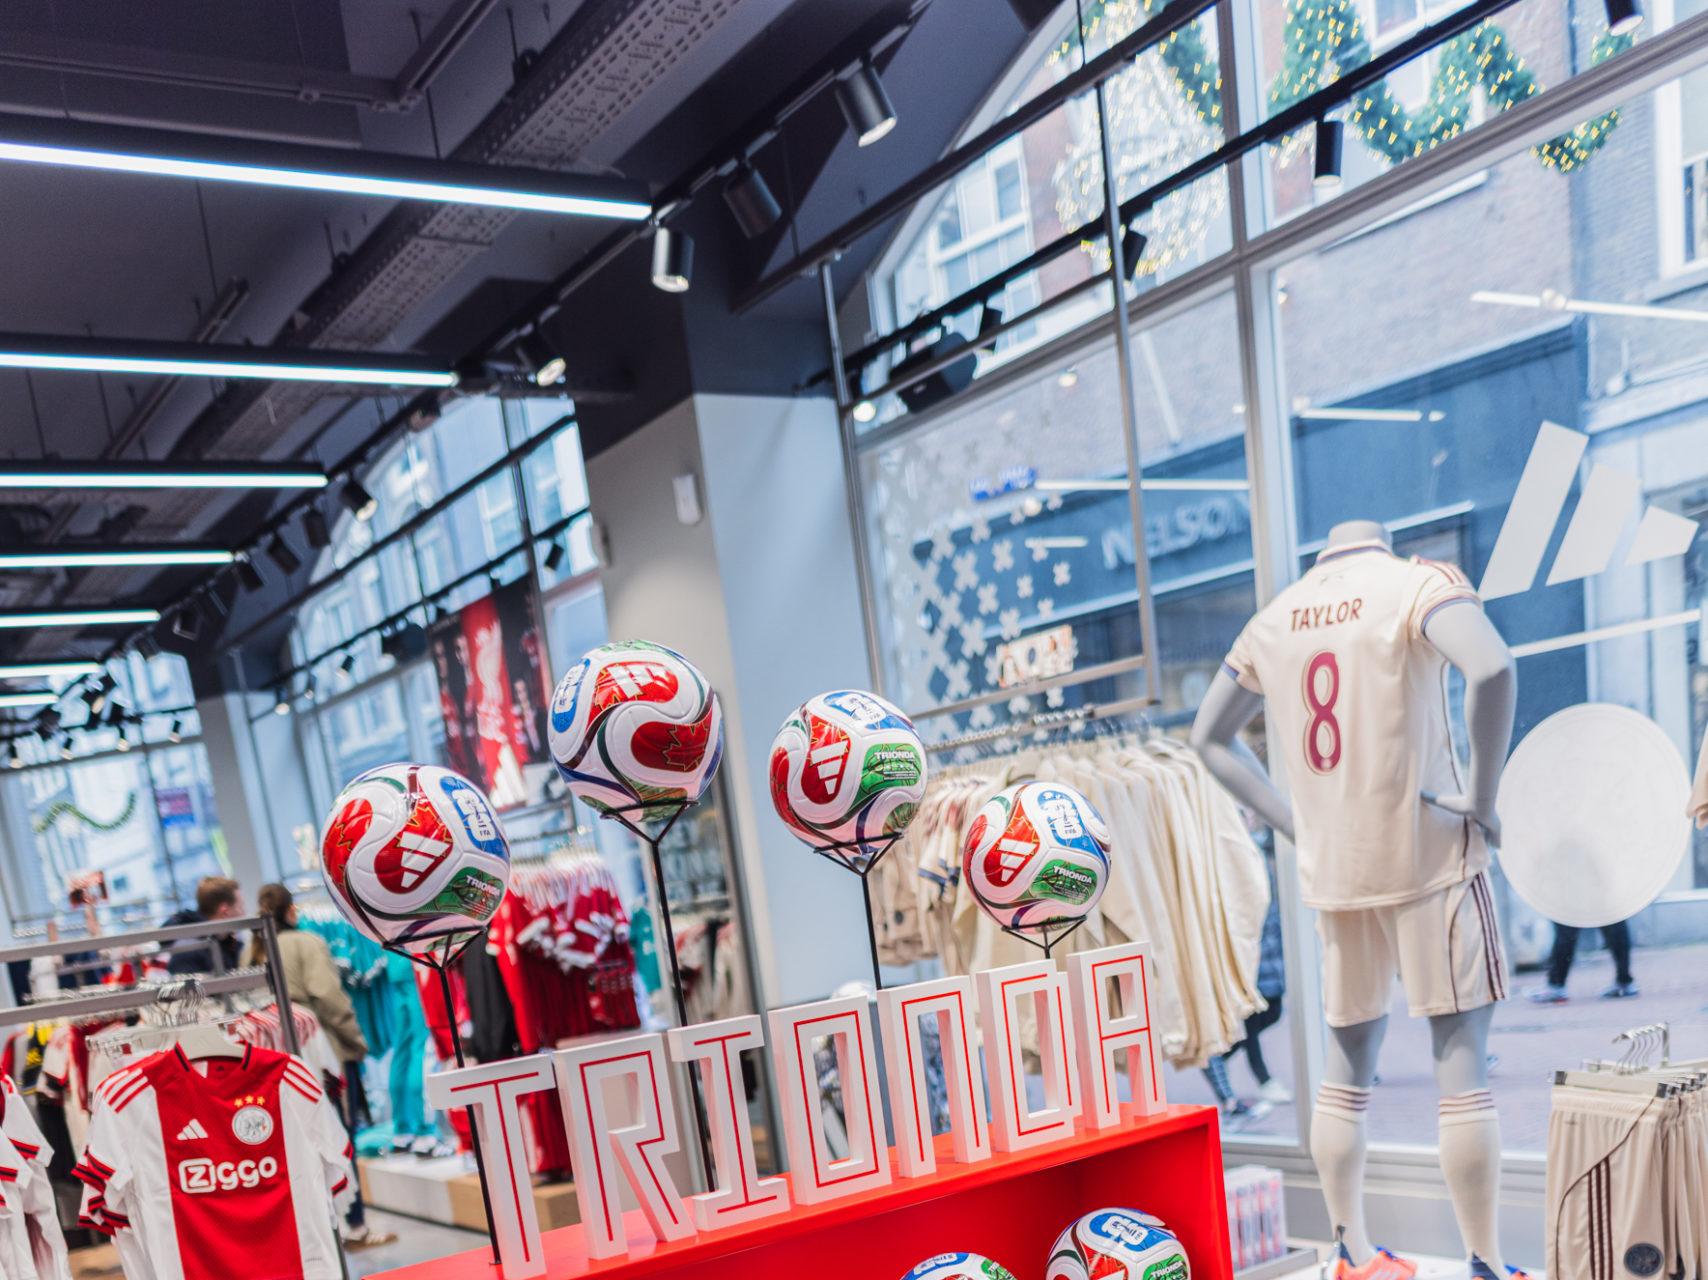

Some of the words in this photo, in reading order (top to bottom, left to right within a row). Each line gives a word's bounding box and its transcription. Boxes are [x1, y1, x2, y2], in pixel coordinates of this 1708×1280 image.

[1291, 598, 1363, 632] TAYLOR
[1304, 650, 1341, 775] 8
[1053, 865, 1093, 884] TRIONDA
